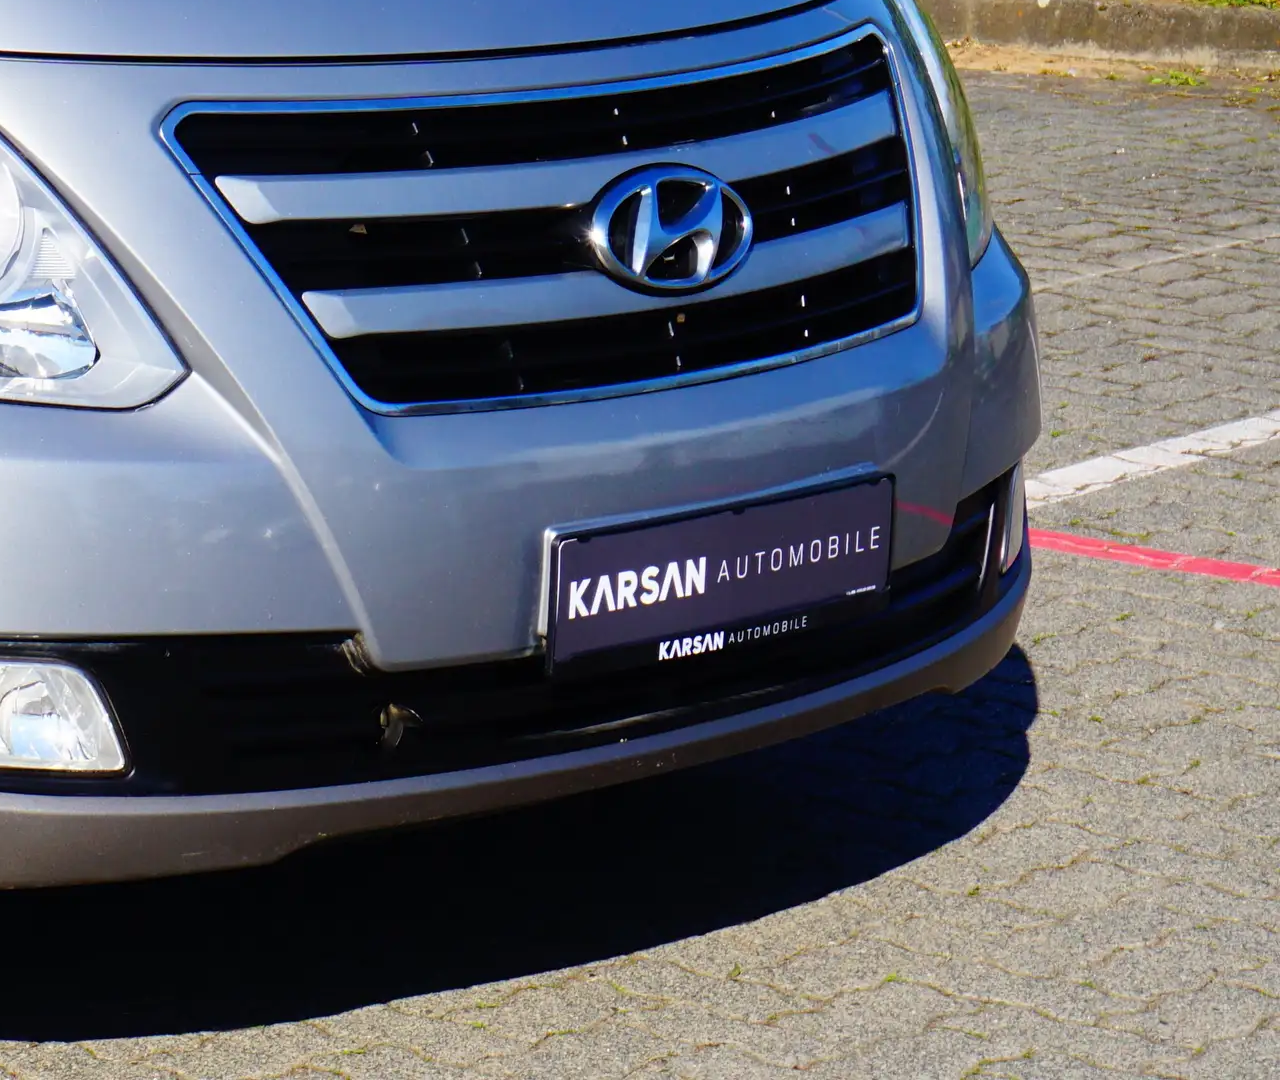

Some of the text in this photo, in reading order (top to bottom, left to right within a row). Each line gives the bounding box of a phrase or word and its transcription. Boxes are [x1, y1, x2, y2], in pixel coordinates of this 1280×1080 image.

[567, 525, 882, 620] KARSAN AUTOMOBILE
[658, 616, 808, 661] KARSAN AUTOMOBILE
